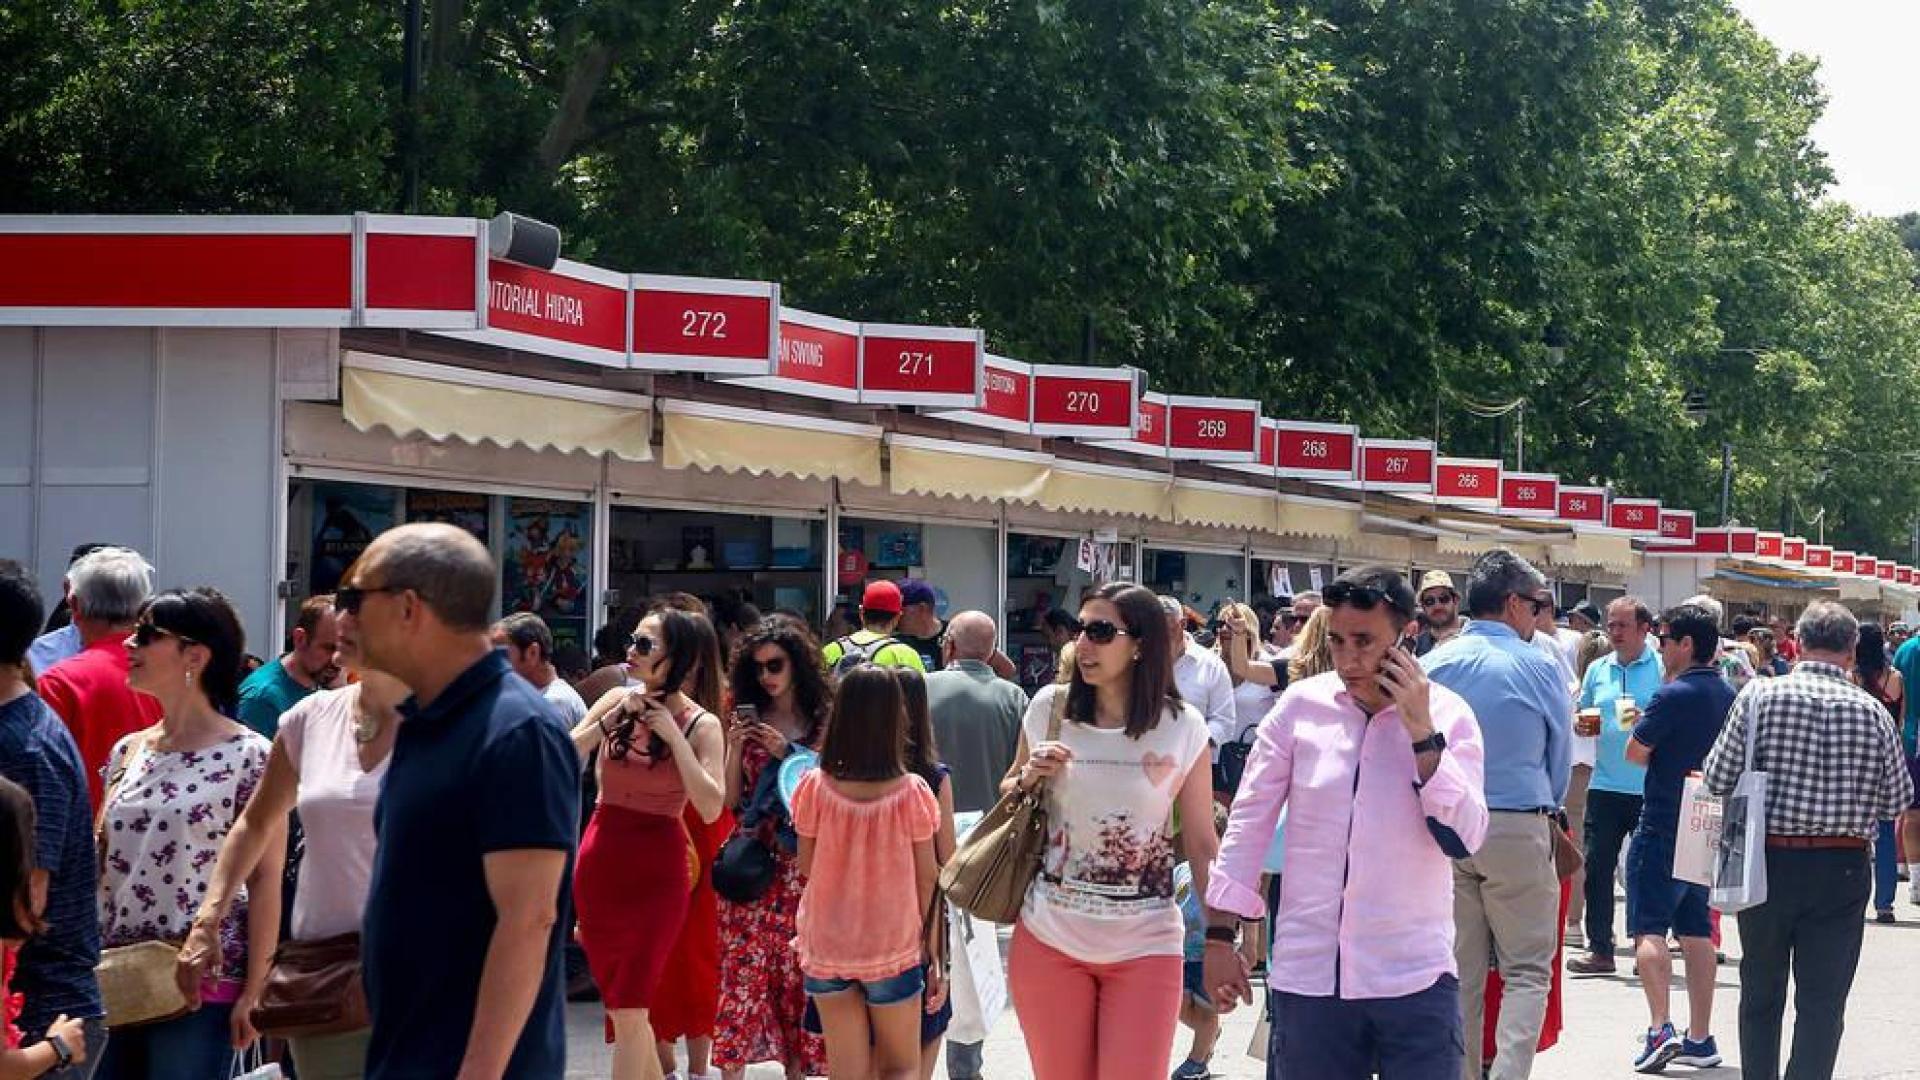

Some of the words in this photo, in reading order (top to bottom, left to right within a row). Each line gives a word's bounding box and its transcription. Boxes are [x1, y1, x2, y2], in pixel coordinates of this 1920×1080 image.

[488, 280, 542, 318] ITORIAL
[545, 290, 584, 327] HIDRA
[682, 309, 727, 338] 272
[791, 340, 823, 367] SWING
[899, 351, 932, 376] 271
[1067, 391, 1099, 412] 270
[1198, 419, 1227, 438] 269
[1302, 440, 1328, 458] 268
[1386, 457, 1409, 474] 267
[1458, 473, 1479, 488] 266
[1518, 485, 1537, 500] 265
[1568, 498, 1587, 512] 264
